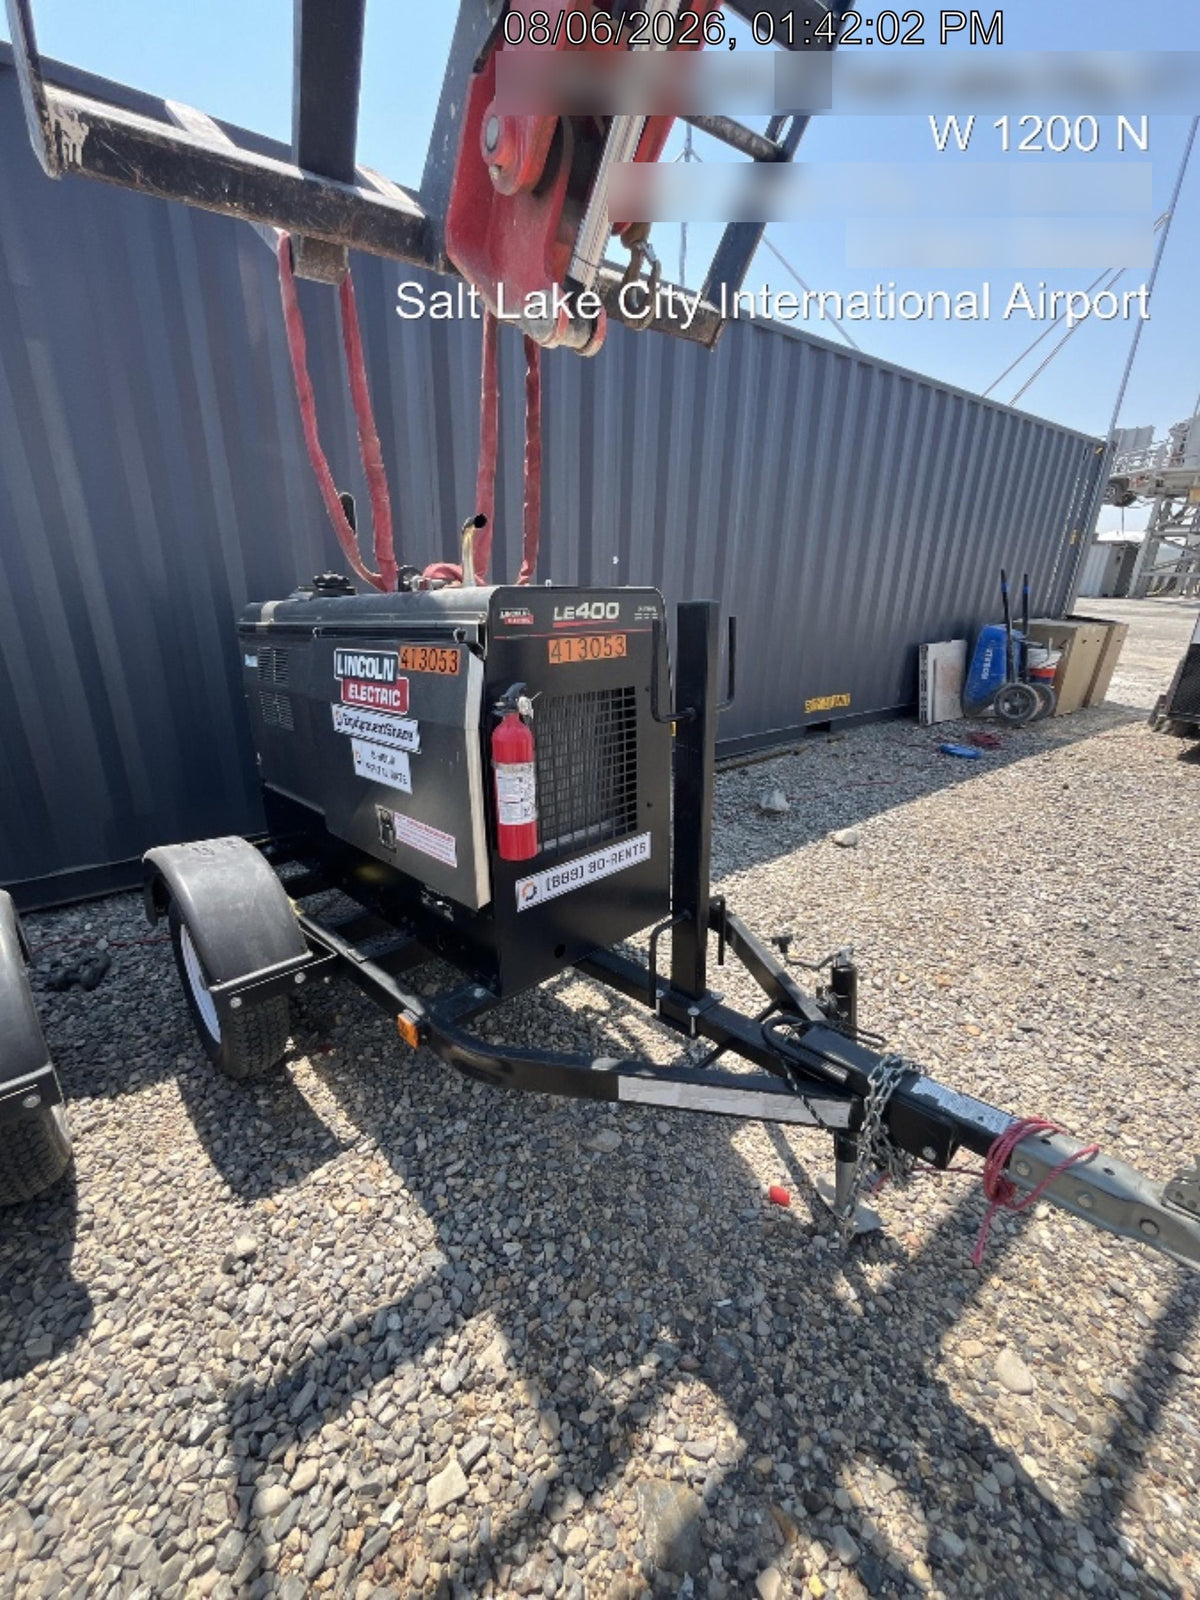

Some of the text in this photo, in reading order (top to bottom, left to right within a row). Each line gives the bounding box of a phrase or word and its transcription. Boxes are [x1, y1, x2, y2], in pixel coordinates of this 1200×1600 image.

[553, 601, 620, 621] LE400
[401, 647, 459, 674] 413053
[550, 636, 625, 662] 413053
[337, 653, 395, 681] LINCOLN
[348, 683, 401, 707] ELECTRIC
